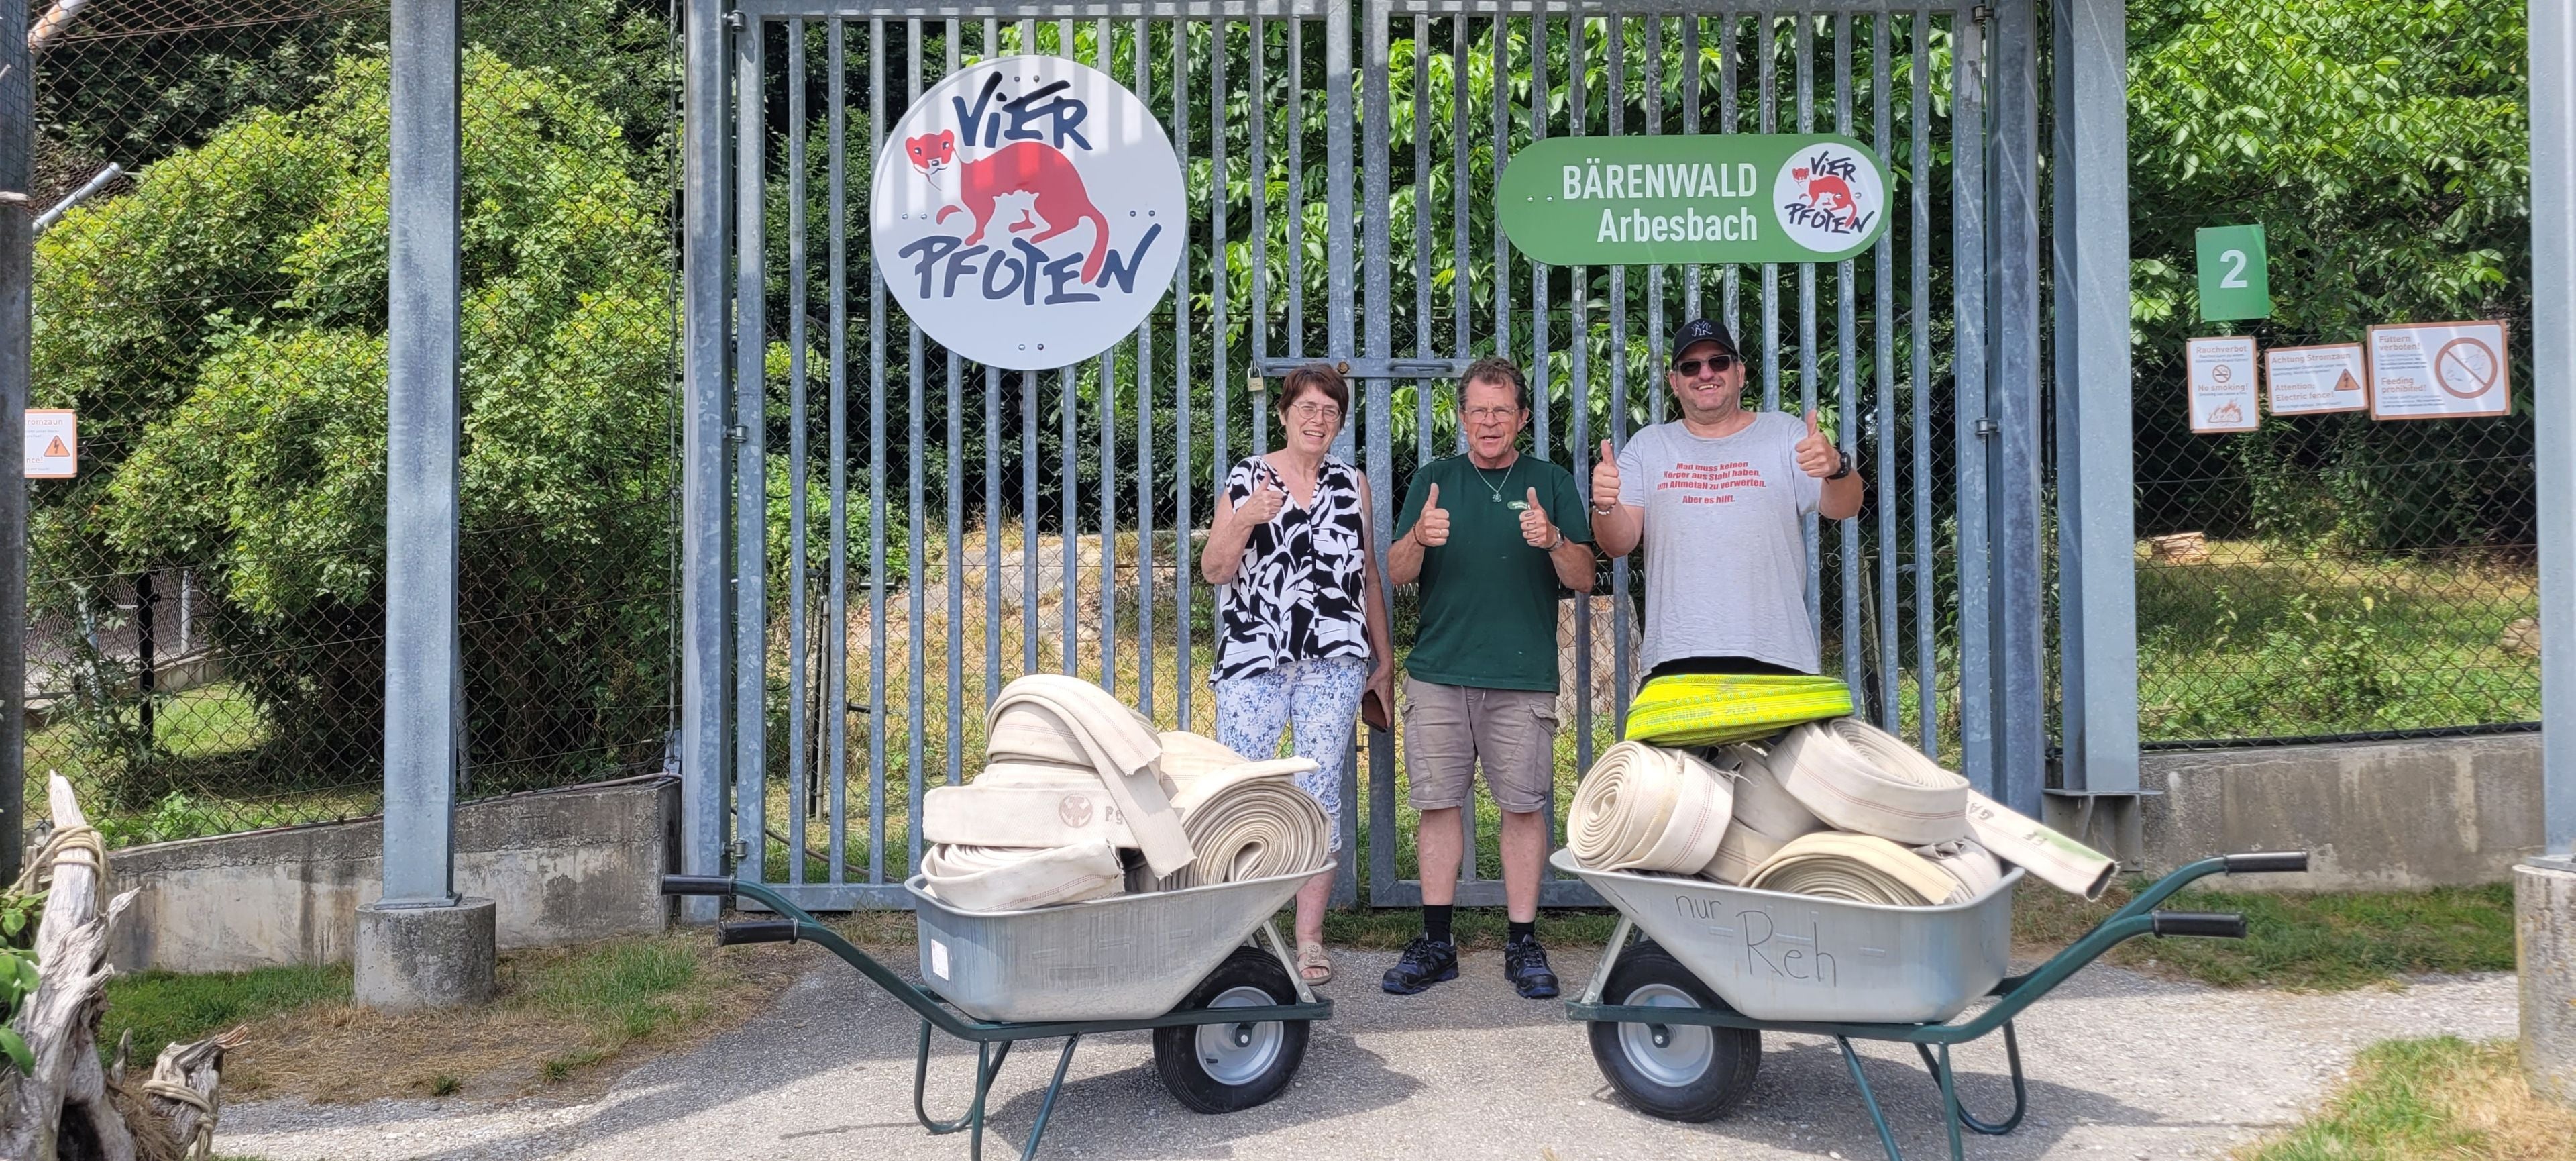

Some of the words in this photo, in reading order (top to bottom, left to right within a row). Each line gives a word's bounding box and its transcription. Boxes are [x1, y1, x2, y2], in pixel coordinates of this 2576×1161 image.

[1563, 158, 1757, 199] BÄRENWALD
[1784, 203, 1874, 234] PFOTEN
[1597, 206, 1758, 242] Arbesbach
[898, 223, 1162, 305] PFOTEN
[2220, 250, 2248, 289] 2
[2379, 335, 2411, 343] Füttern
[2196, 346, 2247, 354] Rauchverbot
[2379, 342, 2421, 351] verboten!
[2272, 356, 2305, 364] Achtung
[2307, 353, 2351, 362] Stromzaun
[2381, 377, 2414, 386] Feeding
[2211, 383, 2249, 392] smoking!
[2275, 383, 2315, 391] Attention:
[2381, 385, 2426, 393] prohibited!
[2276, 393, 2307, 401] Electric
[2309, 391, 2334, 399] fence!
[1720, 462, 1748, 470] keinen
[1664, 471, 1690, 479] Körper
[1709, 471, 1731, 481] Stahl
[1732, 469, 1761, 477] haben,
[1670, 481, 1708, 489] Altmetall
[1721, 478, 1766, 489] verwerten.
[1682, 495, 1703, 503] Aber
[1716, 495, 1736, 503] hilft.
[1674, 895, 1722, 919] nur
[1735, 910, 1837, 987] Reh
